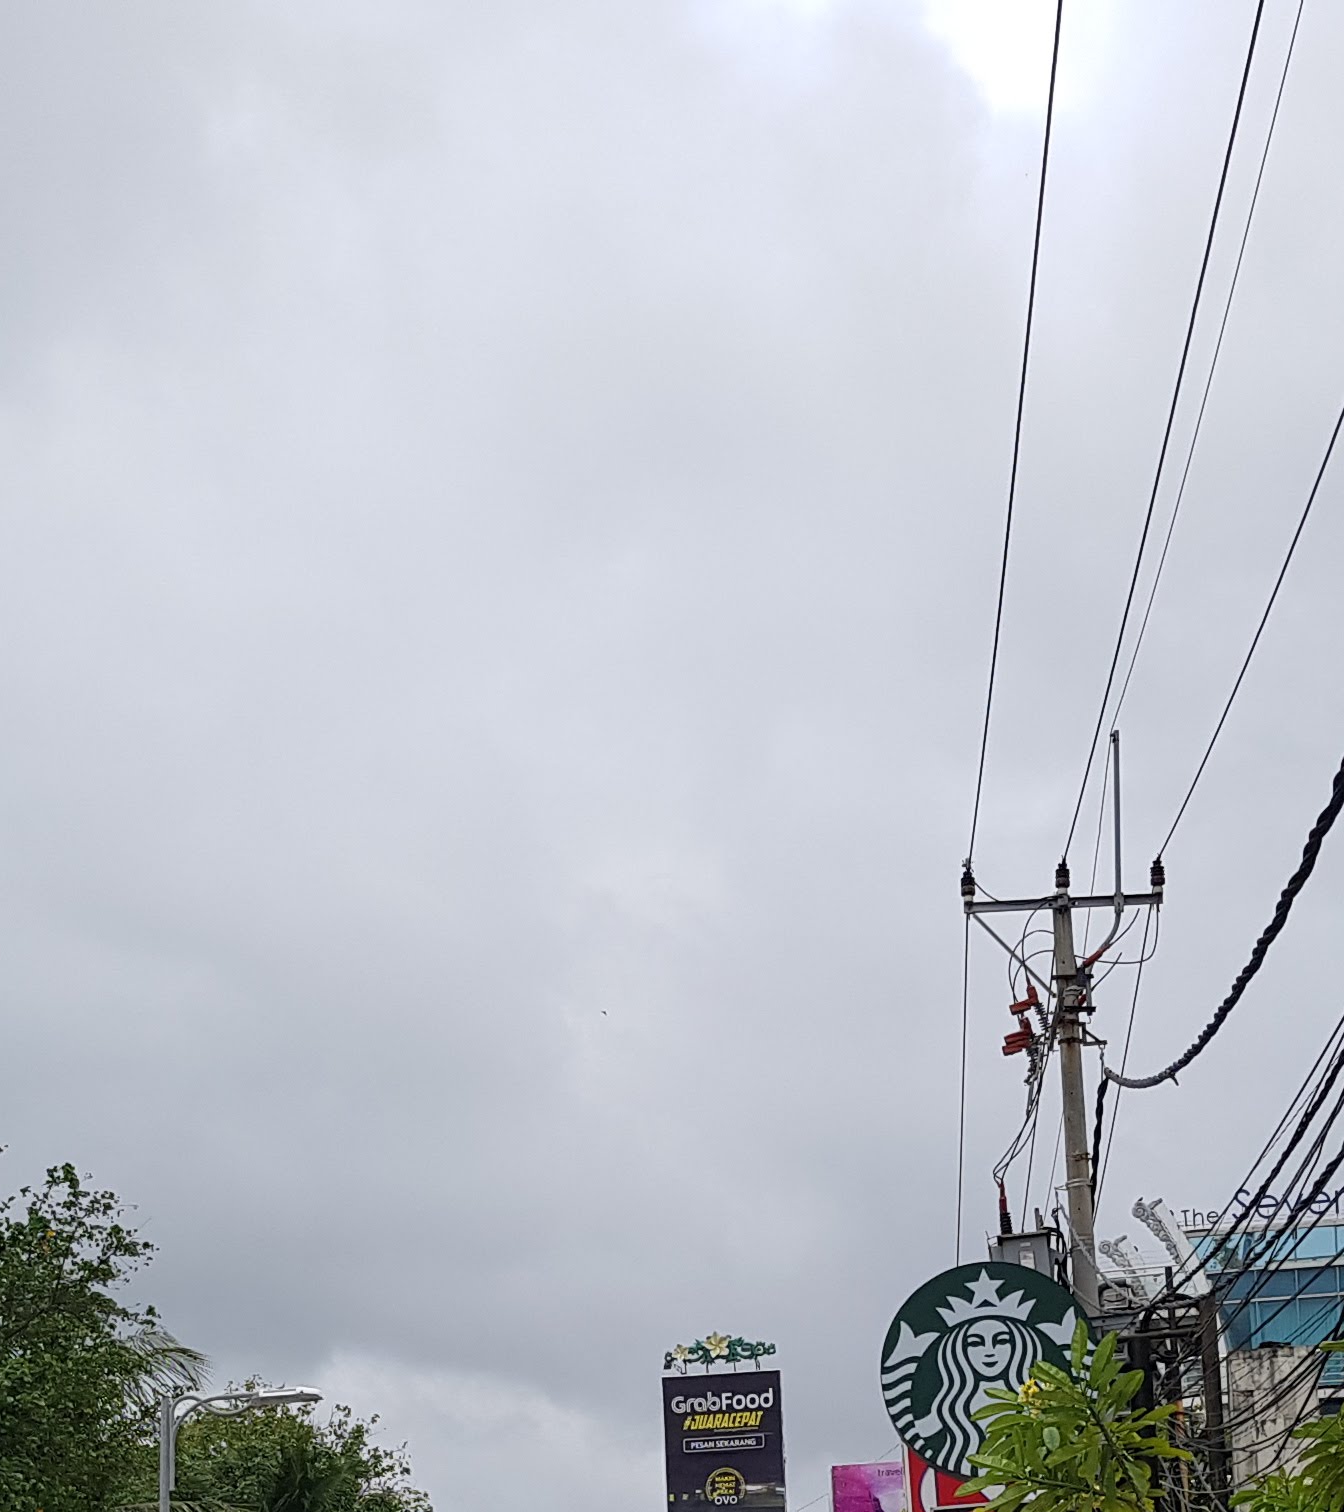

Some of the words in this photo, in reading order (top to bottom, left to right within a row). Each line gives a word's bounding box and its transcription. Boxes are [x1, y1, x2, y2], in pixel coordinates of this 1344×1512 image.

[1181, 1208, 1220, 1228] The
[671, 1387, 774, 1414] GrabFood
[683, 1410, 764, 1431] #JUARACEPAT
[714, 1495, 738, 1506] OVO
